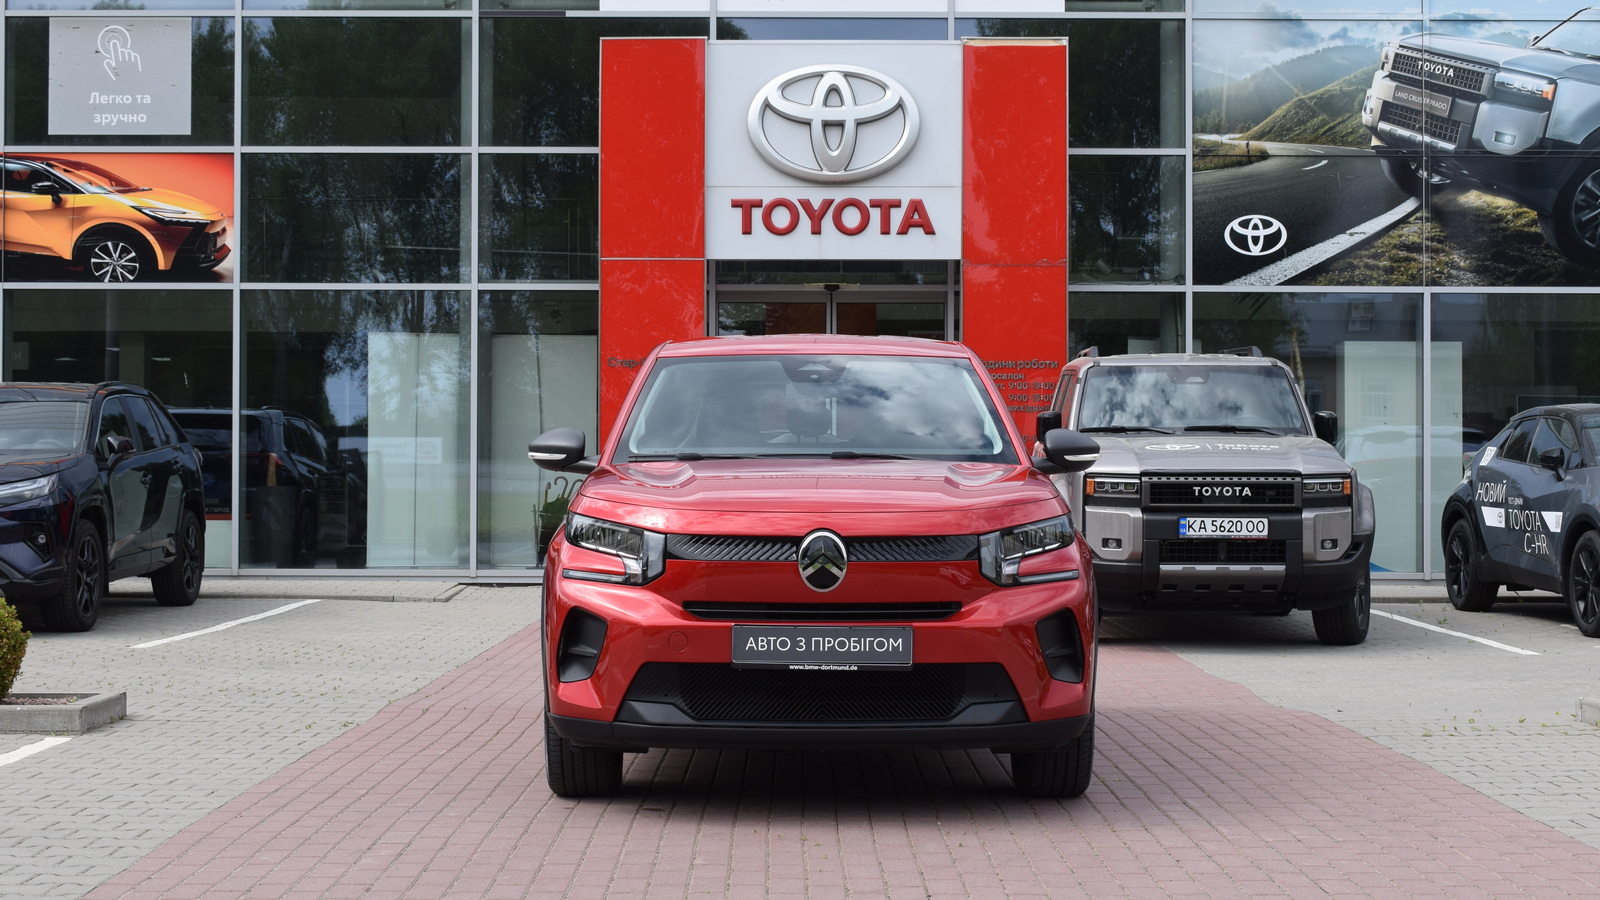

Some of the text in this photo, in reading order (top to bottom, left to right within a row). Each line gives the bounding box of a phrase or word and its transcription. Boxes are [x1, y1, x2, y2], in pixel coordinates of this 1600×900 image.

[1418, 61, 1454, 77] TOYOTA
[89, 92, 151, 104] Легко та
[1395, 91, 1447, 110] LAND CRUISER PRADO
[93, 113, 147, 126] зручно
[730, 197, 936, 237] TOYOTA
[607, 357, 645, 369] Стар-
[981, 359, 1059, 370] одини роботи
[1193, 486, 1252, 496] TOYOTA
[1475, 480, 1507, 503] НОВИЙ
[1211, 520, 1243, 533] 5620
[1508, 509, 1543, 531] TOYOTA
[1524, 532, 1549, 555] C-HR
[745, 637, 791, 651] АВТО
[811, 637, 903, 652] ПРОБІГОМ
